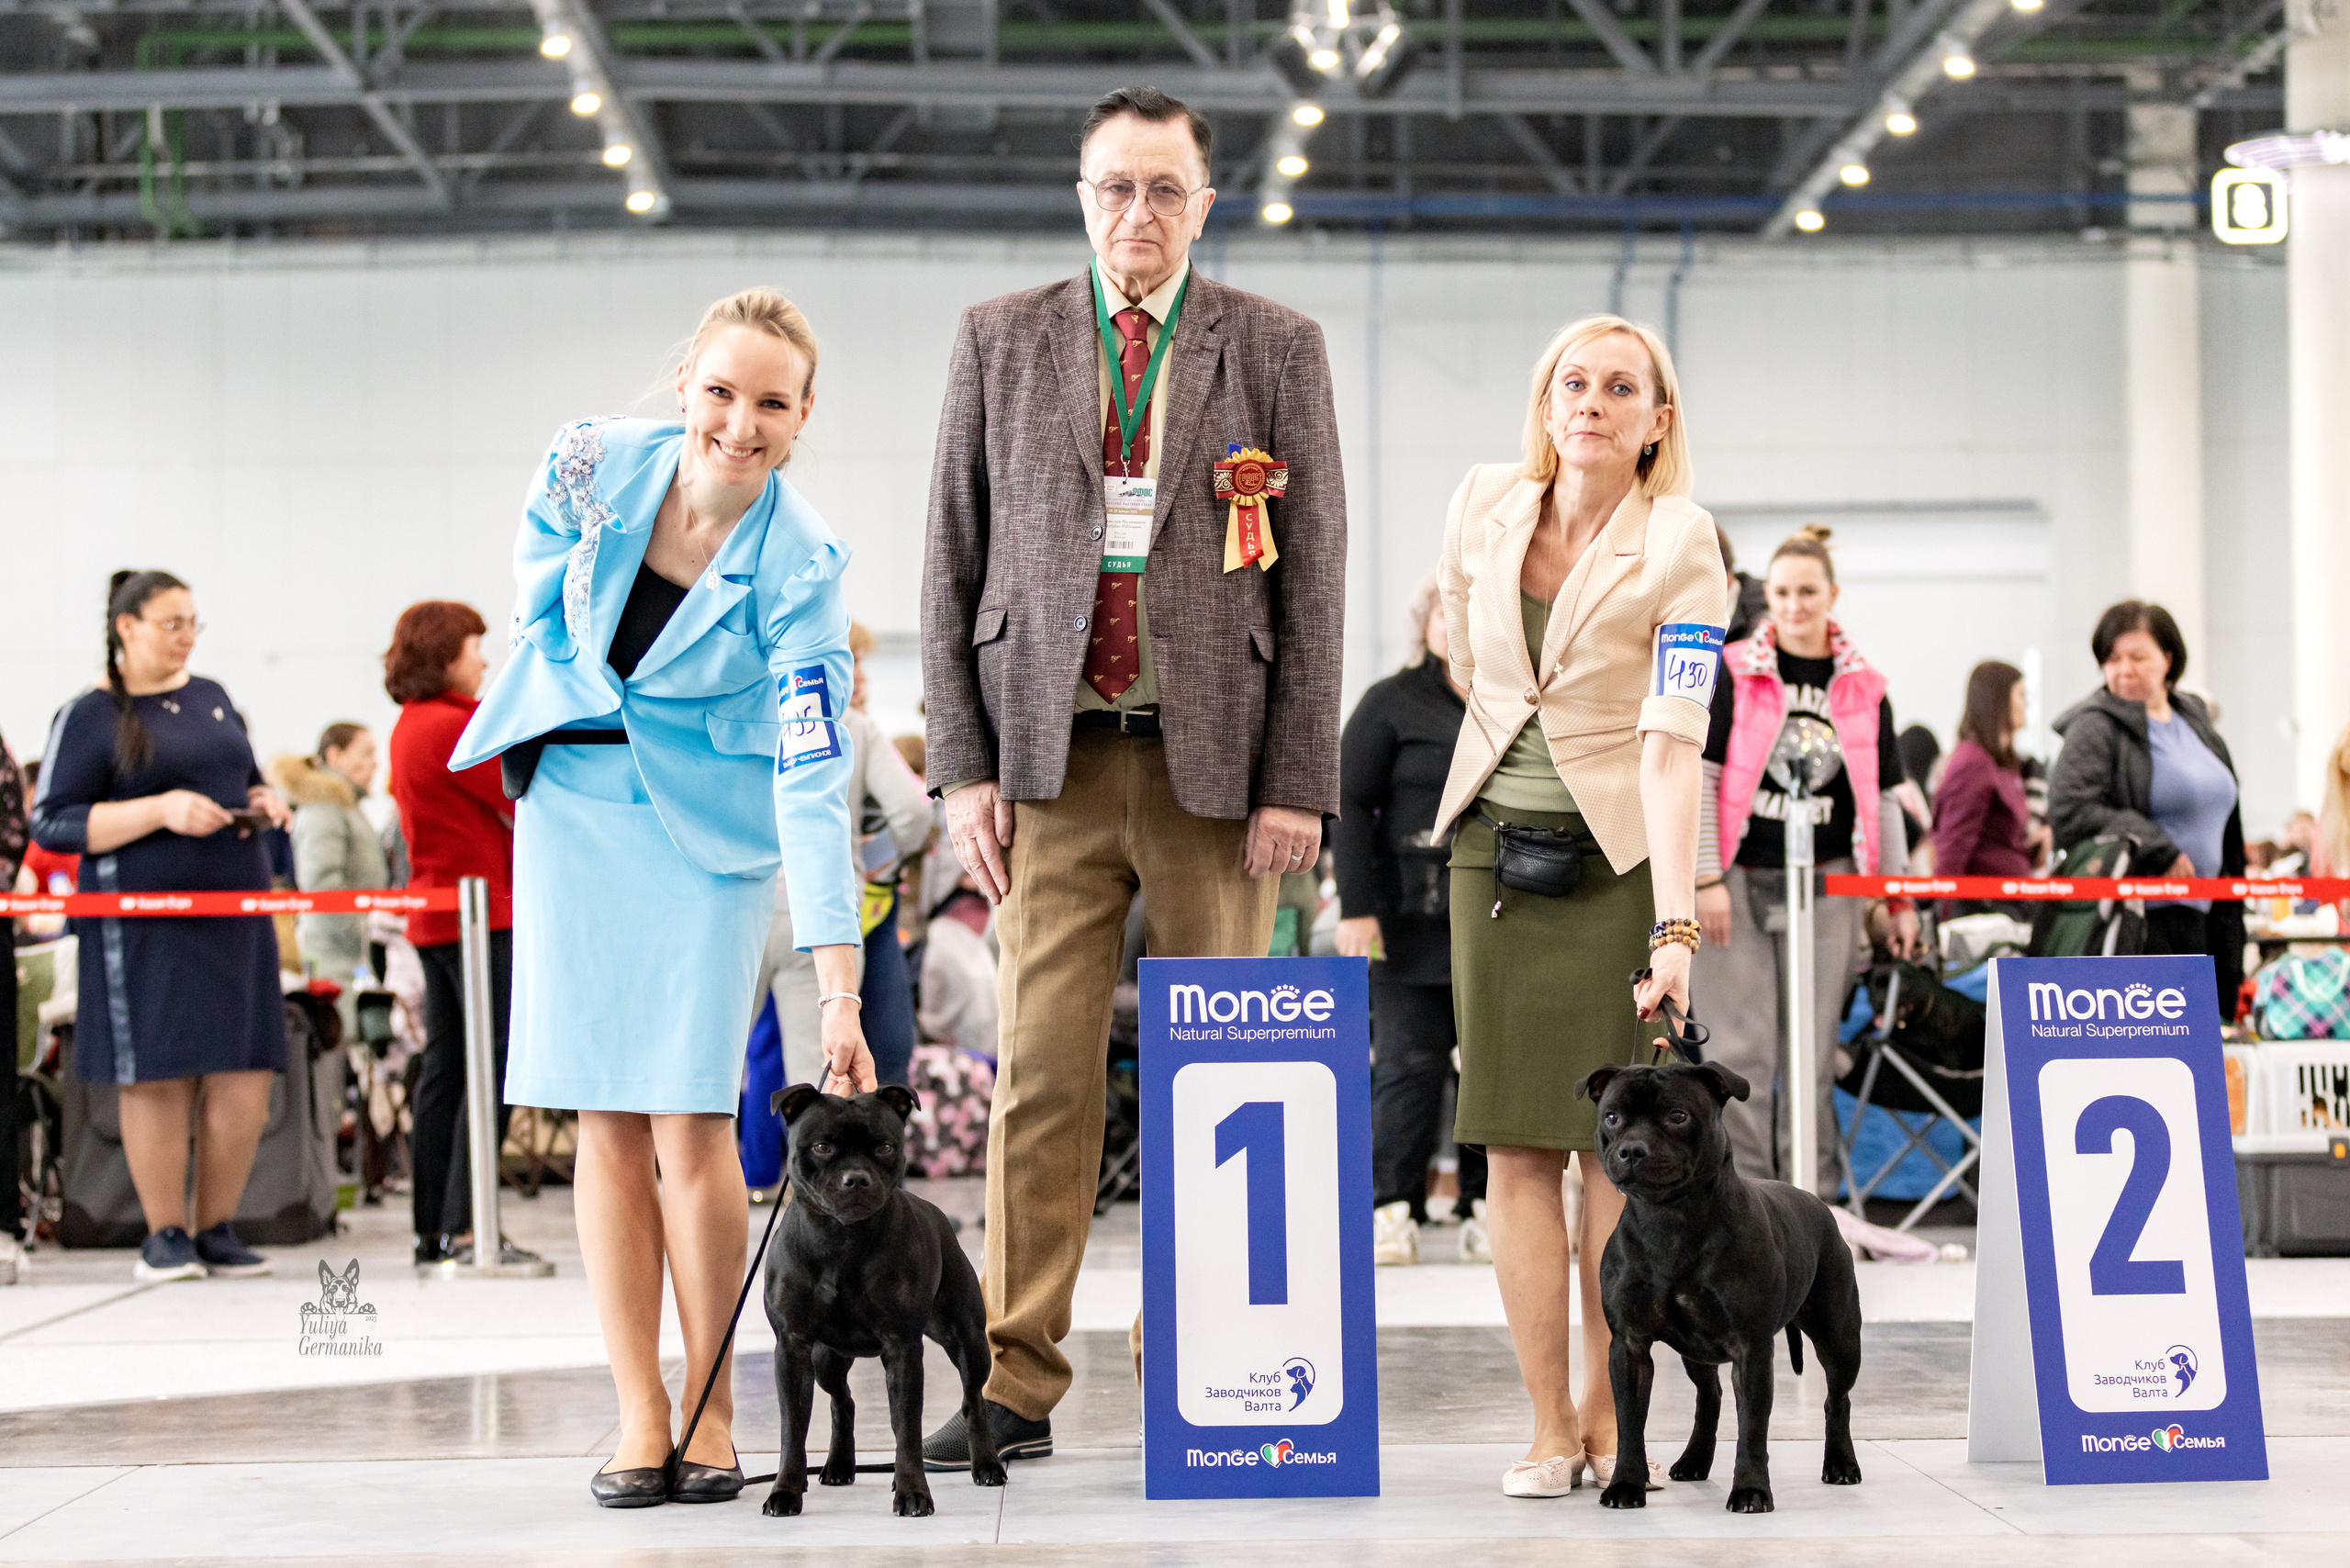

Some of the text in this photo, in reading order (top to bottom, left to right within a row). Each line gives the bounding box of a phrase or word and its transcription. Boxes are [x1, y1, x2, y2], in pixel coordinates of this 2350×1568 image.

[1245, 513, 1257, 557] СУДЬЯ
[1669, 654, 1707, 689] 430
[798, 678, 823, 688] Семья
[798, 749, 832, 762] ЧЕМПИОНОВ
[1169, 1025, 1336, 1042] Natural Superpremium
[2031, 1023, 2189, 1039] Natural Superpremium
[2075, 1095, 2187, 1295] 2
[1214, 1102, 1288, 1305] 1
[2134, 1359, 2165, 1372] Клуб
[1249, 1372, 1281, 1385] Клуб
[2094, 1374, 2166, 1386] Заводчиков
[1205, 1387, 1281, 1399] Заводчиков
[2132, 1388, 2168, 1398] Валта
[1245, 1401, 1281, 1412] Валта
[2173, 1437, 2225, 1450] Семья
[1282, 1450, 1337, 1464] Семья
